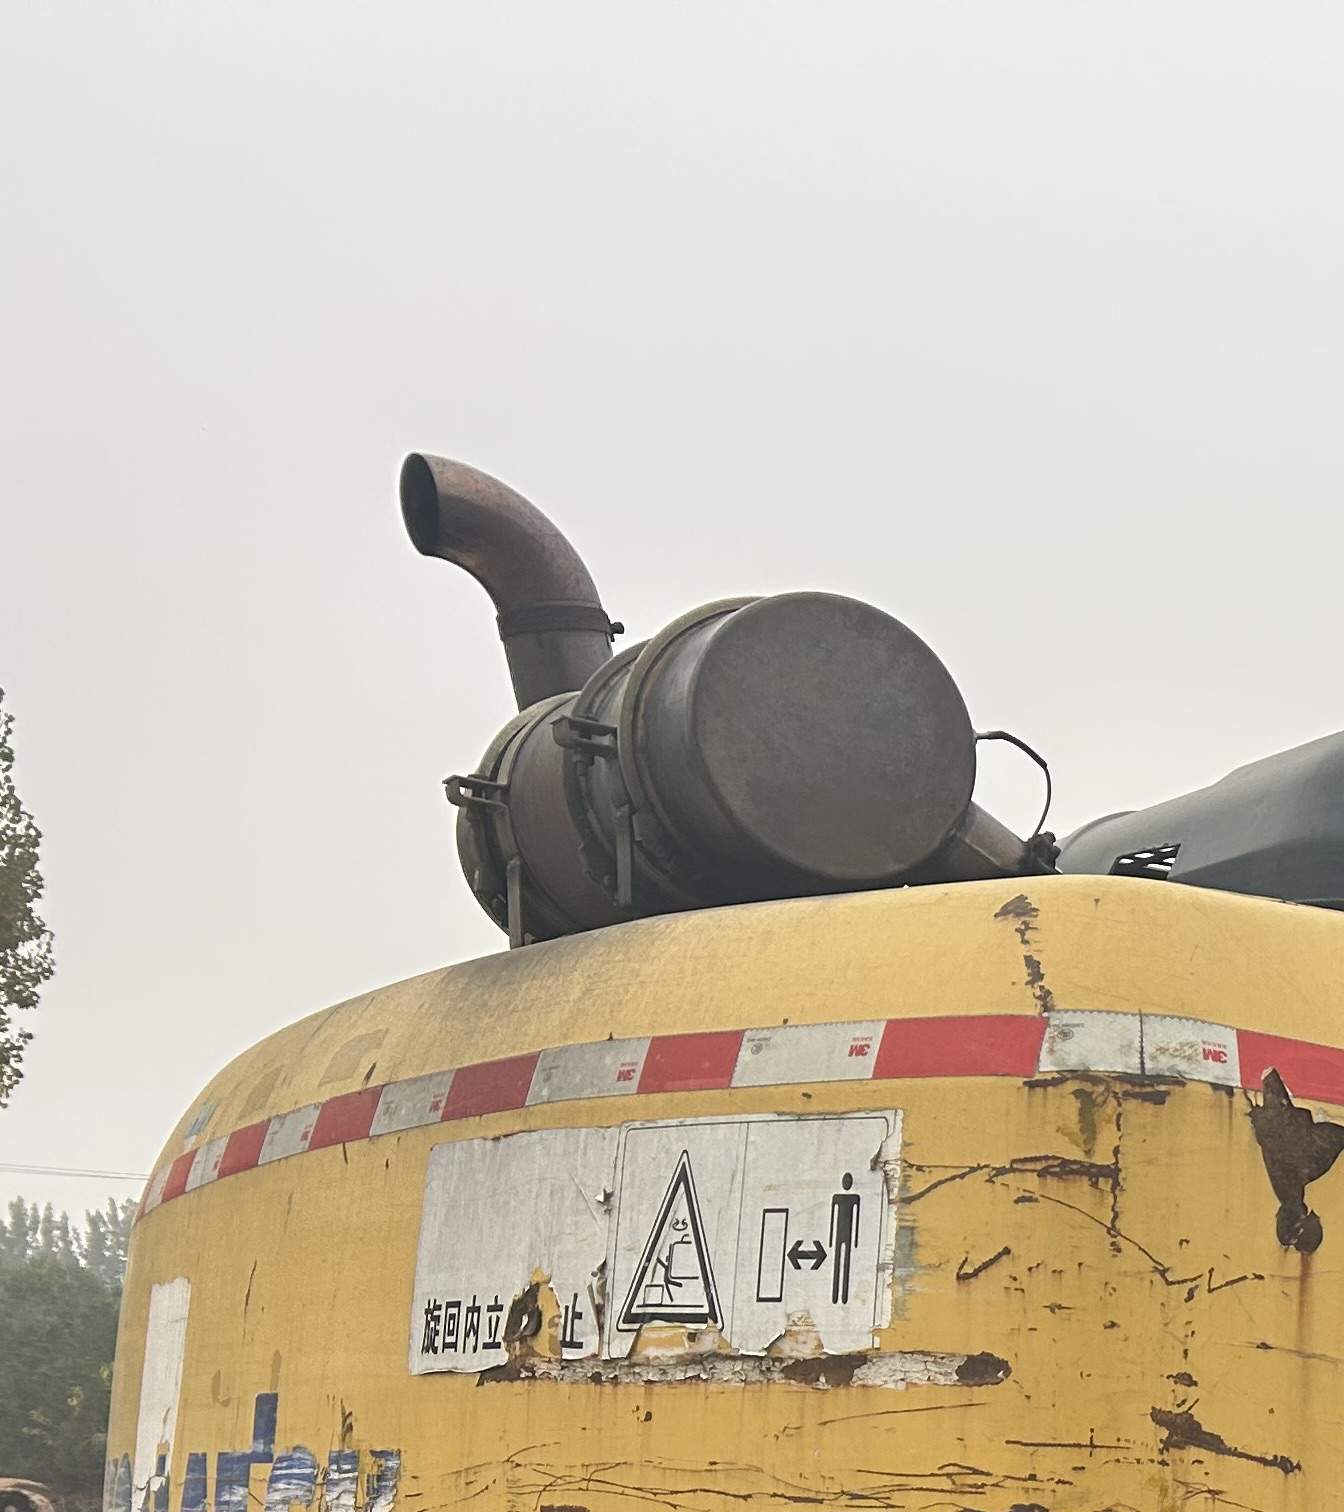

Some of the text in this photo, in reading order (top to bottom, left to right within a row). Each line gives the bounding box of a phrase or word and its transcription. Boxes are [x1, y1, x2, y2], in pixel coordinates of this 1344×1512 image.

[1202, 1047, 1228, 1063] 3M
[421, 1292, 583, 1355] 旋回内立止
